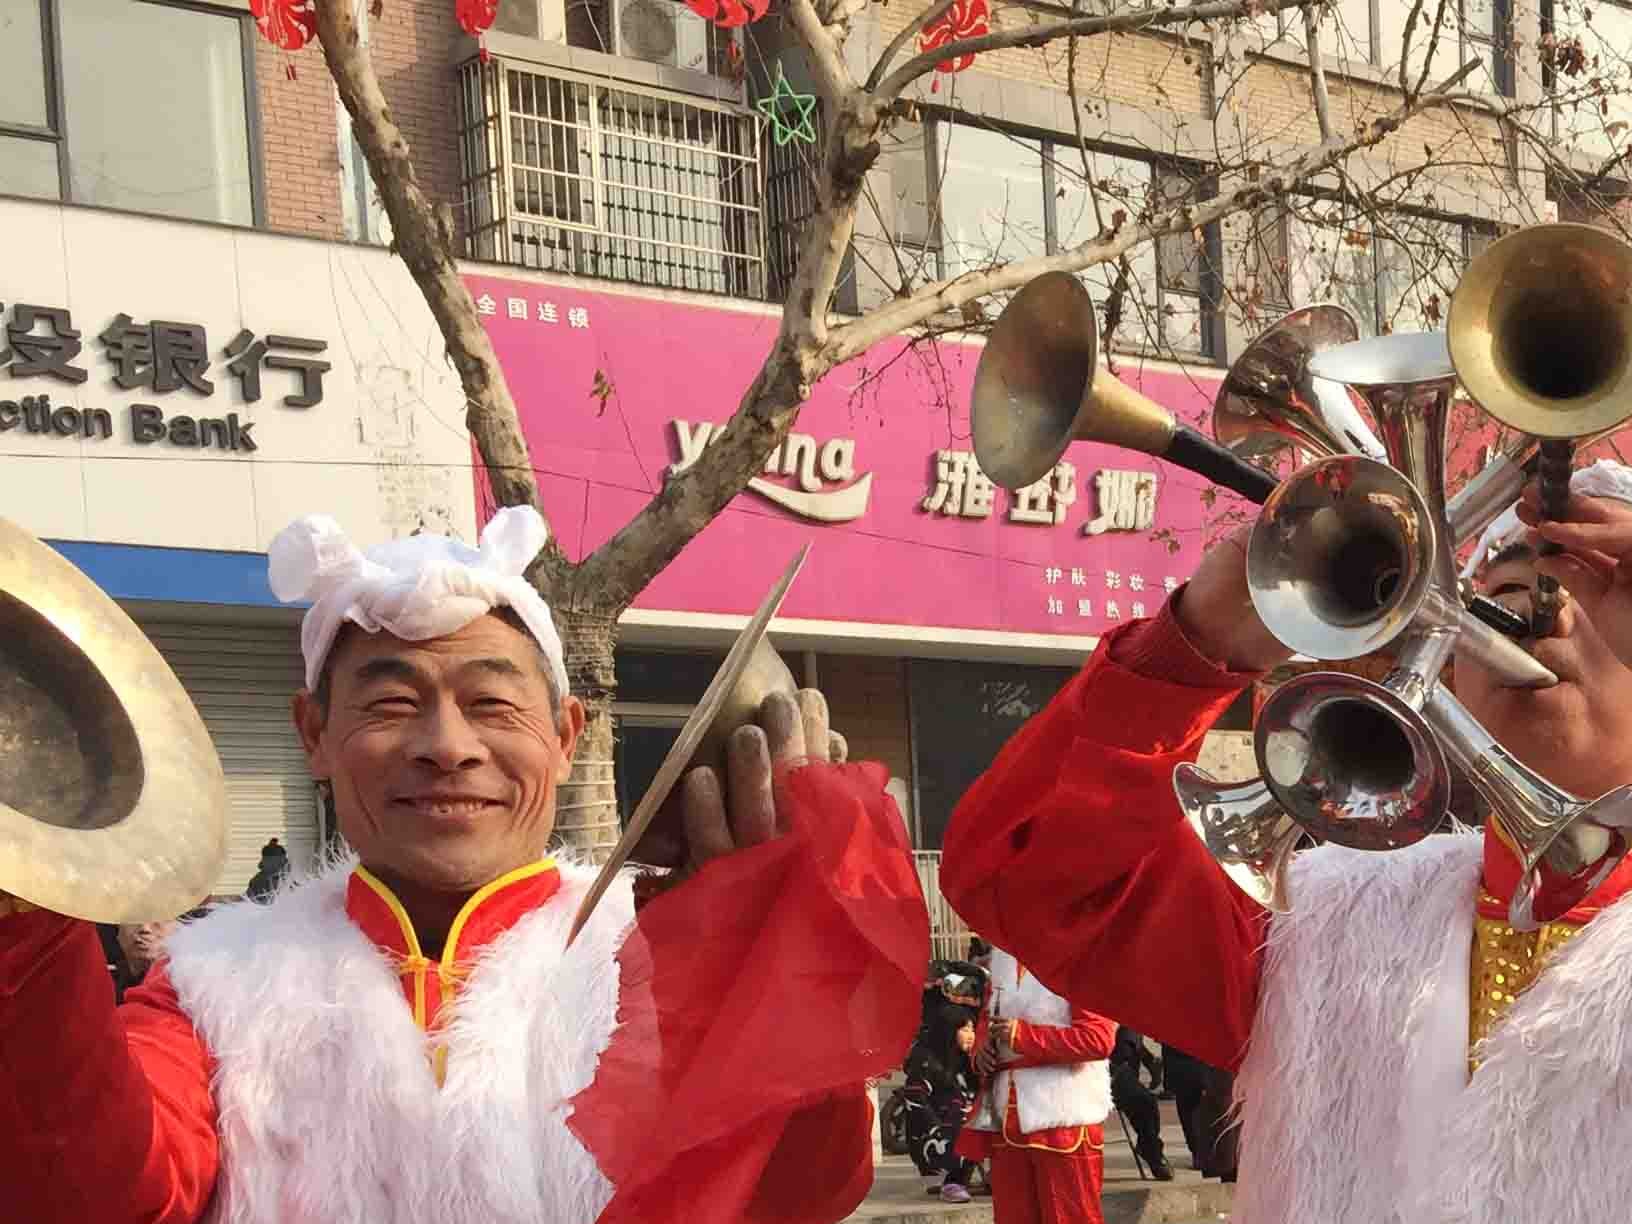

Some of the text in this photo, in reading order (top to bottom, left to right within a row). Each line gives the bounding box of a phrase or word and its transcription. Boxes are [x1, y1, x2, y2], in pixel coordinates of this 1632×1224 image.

[476, 293, 590, 329] 全国连锁
[130, 402, 258, 453] Bank
